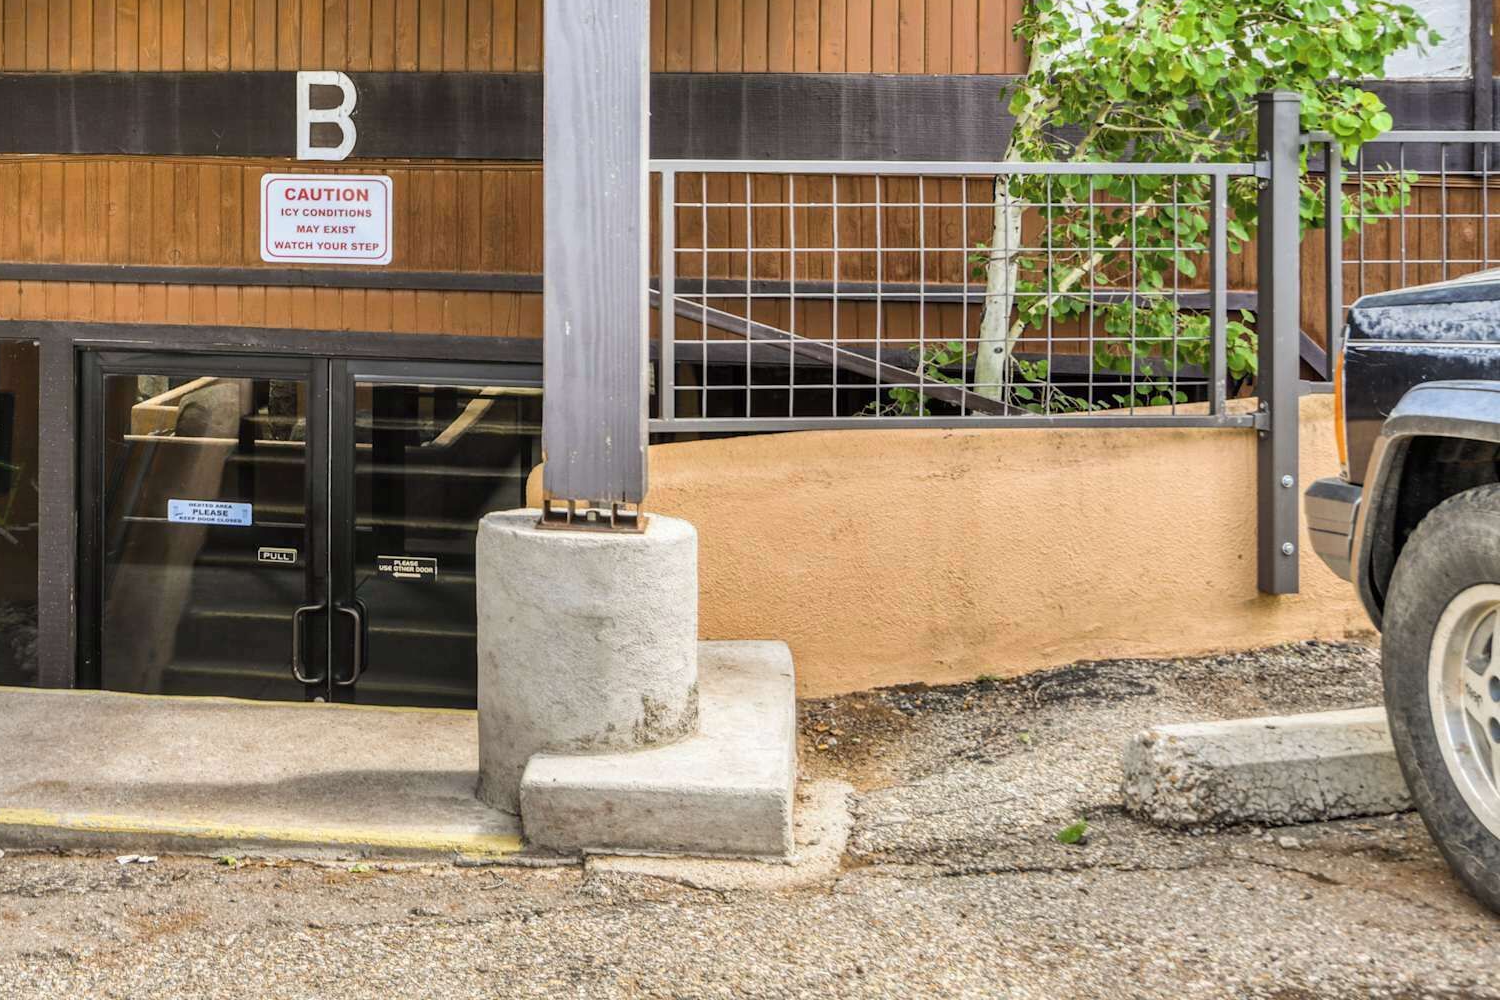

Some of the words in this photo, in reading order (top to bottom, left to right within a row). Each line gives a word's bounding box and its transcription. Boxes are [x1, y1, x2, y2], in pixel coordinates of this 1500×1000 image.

[296, 70, 357, 161] B
[284, 187, 369, 202] CAUTION
[281, 208, 299, 217] ICY
[302, 208, 373, 218] CONDITIONS
[296, 225, 320, 234] MAY
[323, 225, 356, 234] EXIST
[274, 241, 313, 250] WATCH
[316, 241, 348, 251] YOUR
[351, 242, 380, 252] STEP
[192, 508, 229, 517] PLEASE
[263, 552, 290, 561] PULL
[393, 559, 419, 567] PLEASE
[393, 565, 415, 573] OTHER
[415, 566, 434, 574] DOOR
